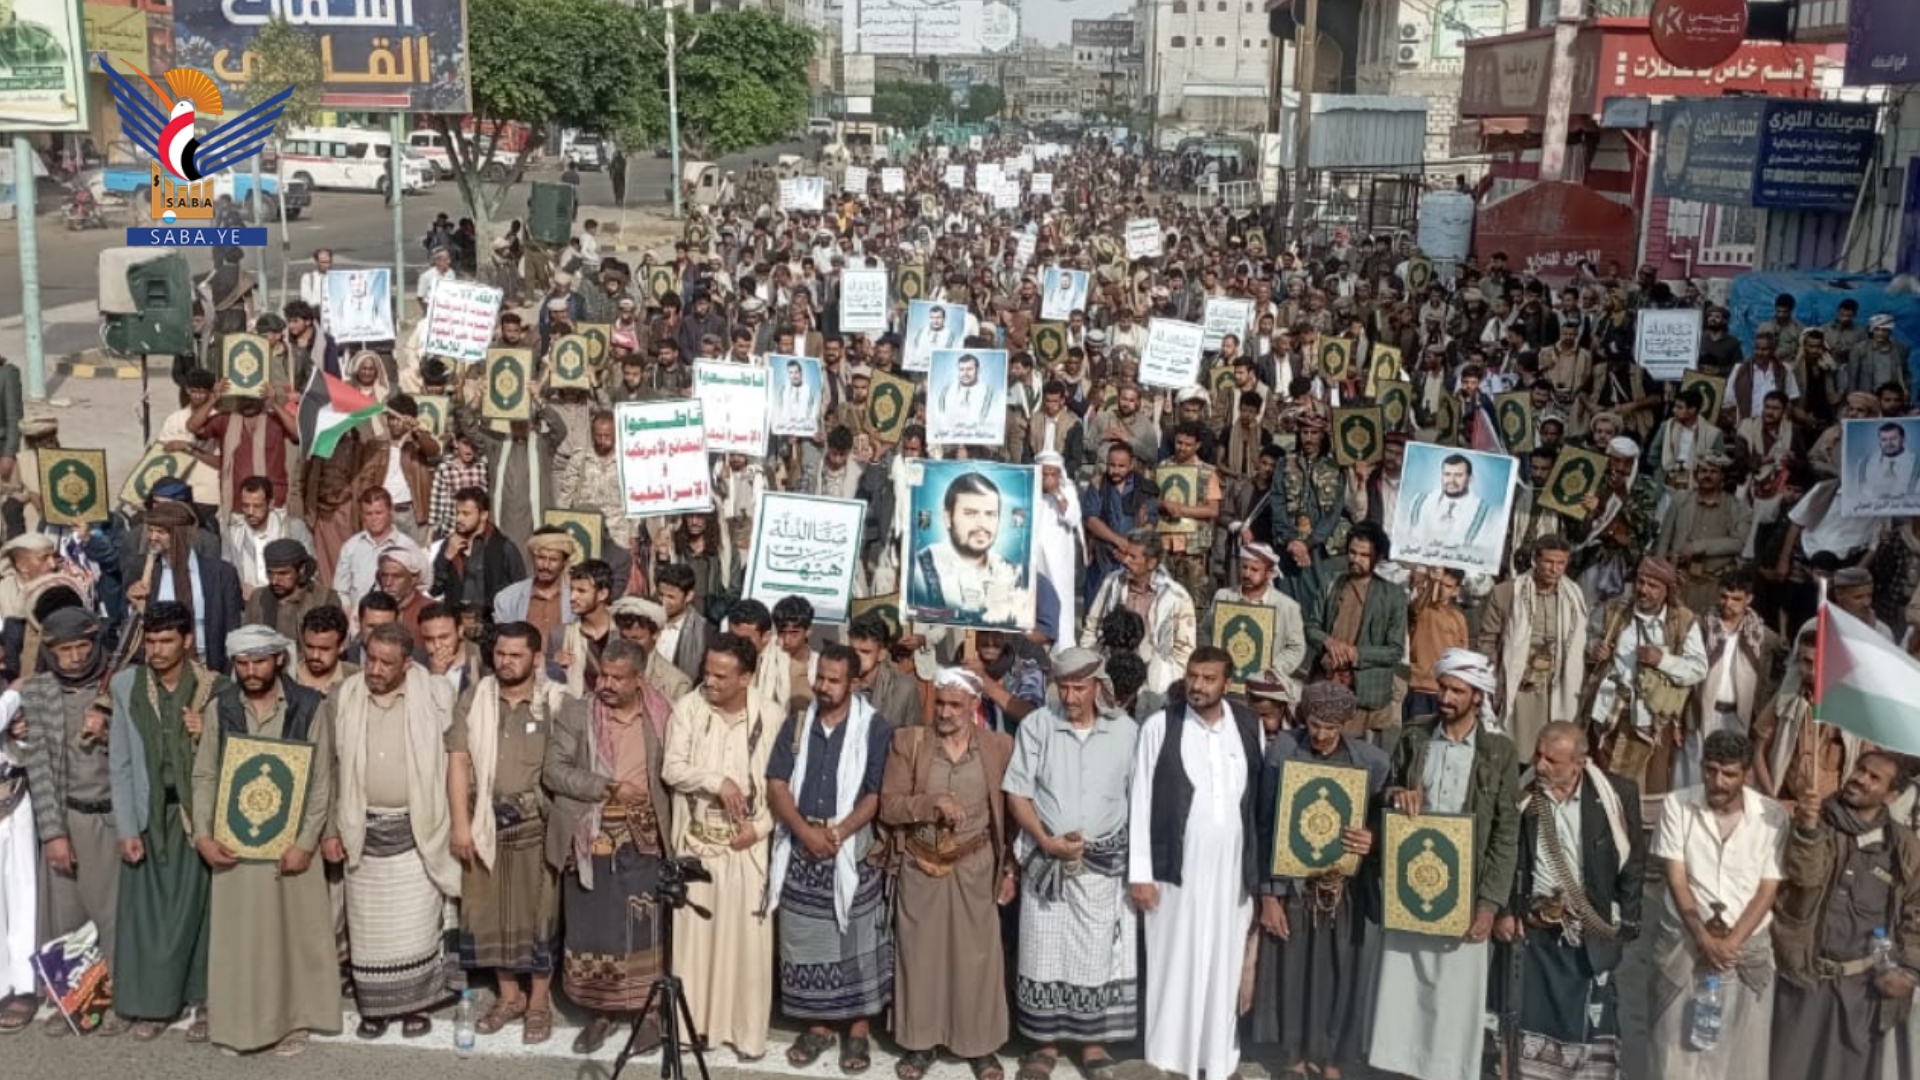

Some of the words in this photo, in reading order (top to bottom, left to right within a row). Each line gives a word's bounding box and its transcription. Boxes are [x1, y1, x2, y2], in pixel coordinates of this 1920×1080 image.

[213, 35, 431, 91] القاي
[1633, 56, 1715, 85] بعائلات
[1714, 56, 1758, 84] خاص
[1760, 58, 1805, 83] قسم
